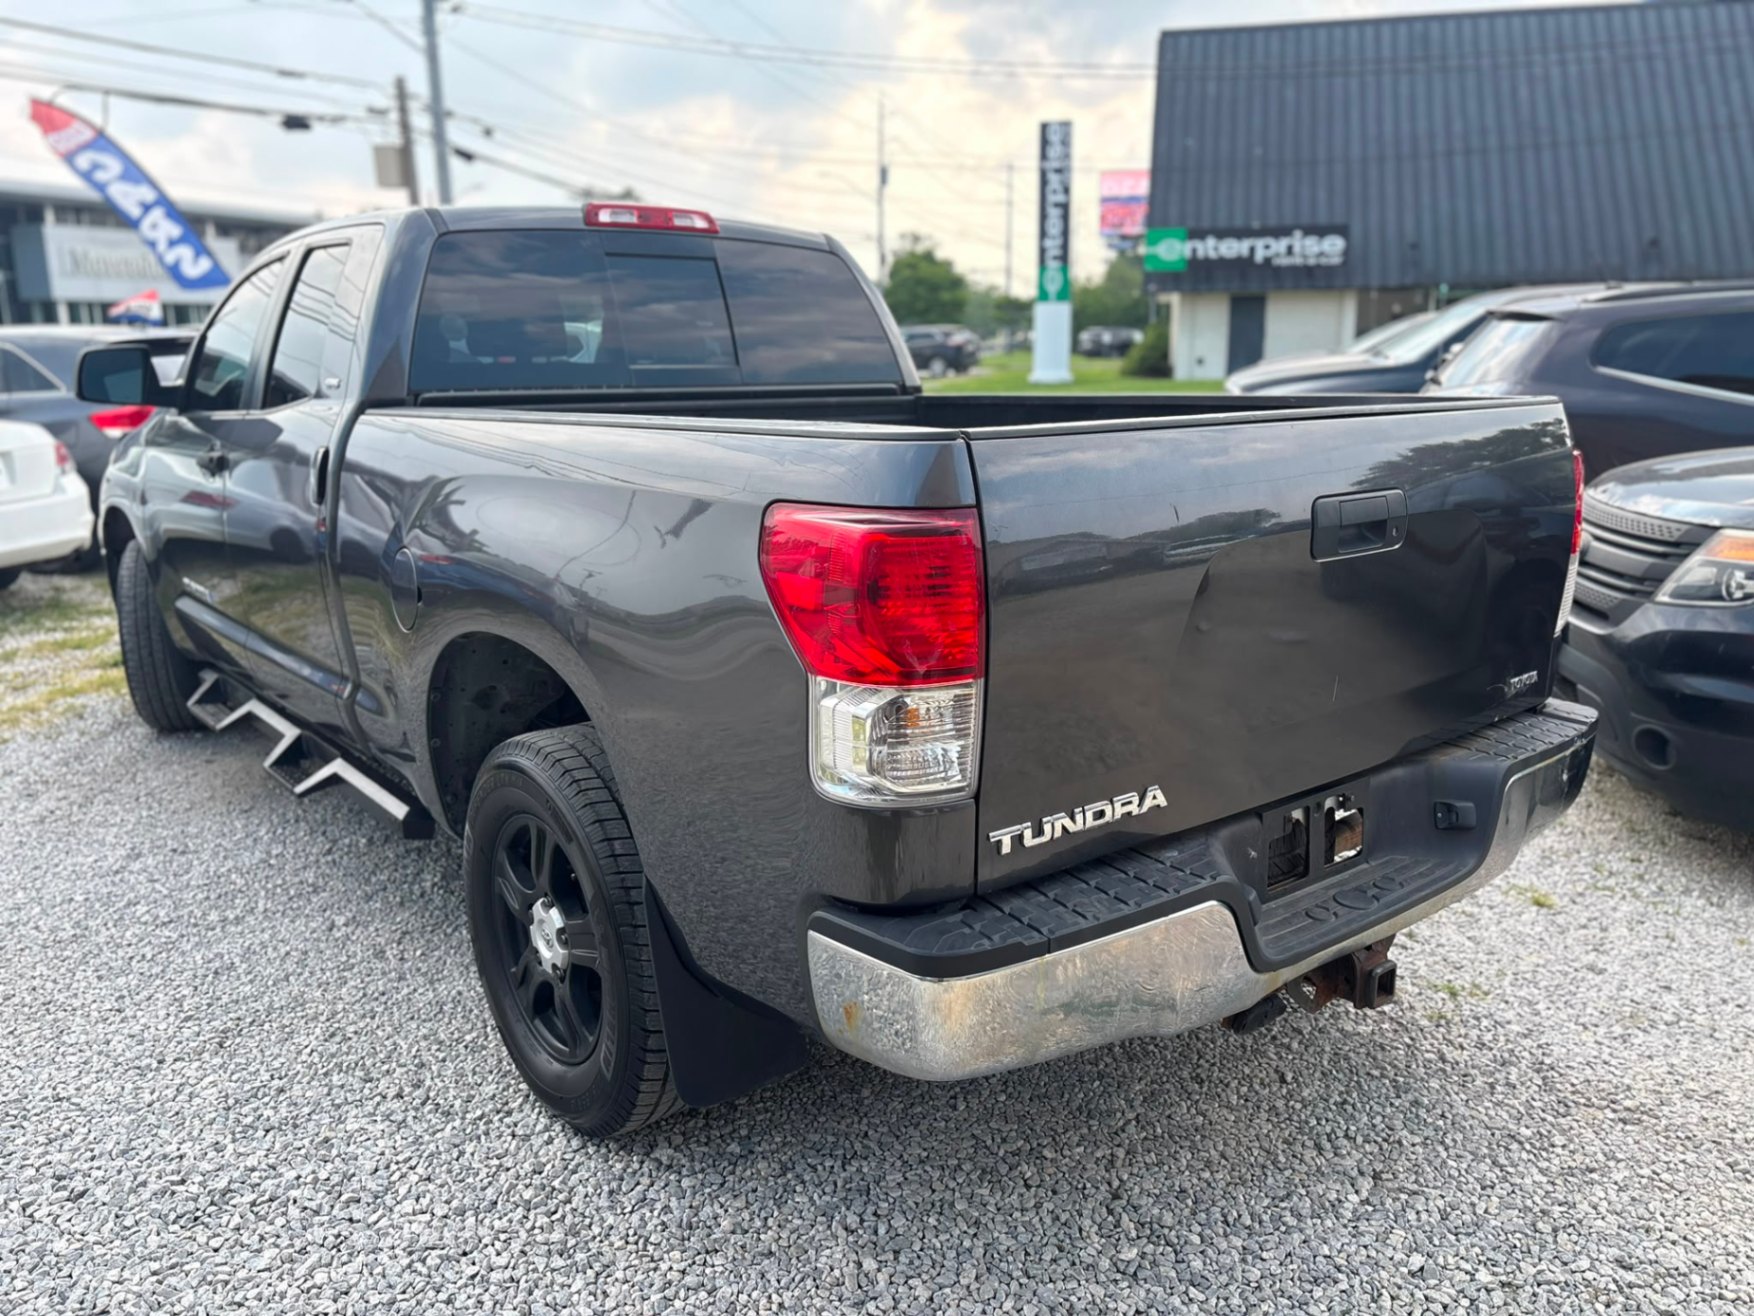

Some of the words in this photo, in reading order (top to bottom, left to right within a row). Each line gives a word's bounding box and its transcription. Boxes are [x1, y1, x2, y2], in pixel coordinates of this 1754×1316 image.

[1041, 121, 1069, 294] enterprise
[1151, 229, 1347, 264] enterprise
[988, 785, 1168, 855] TUNDRA
